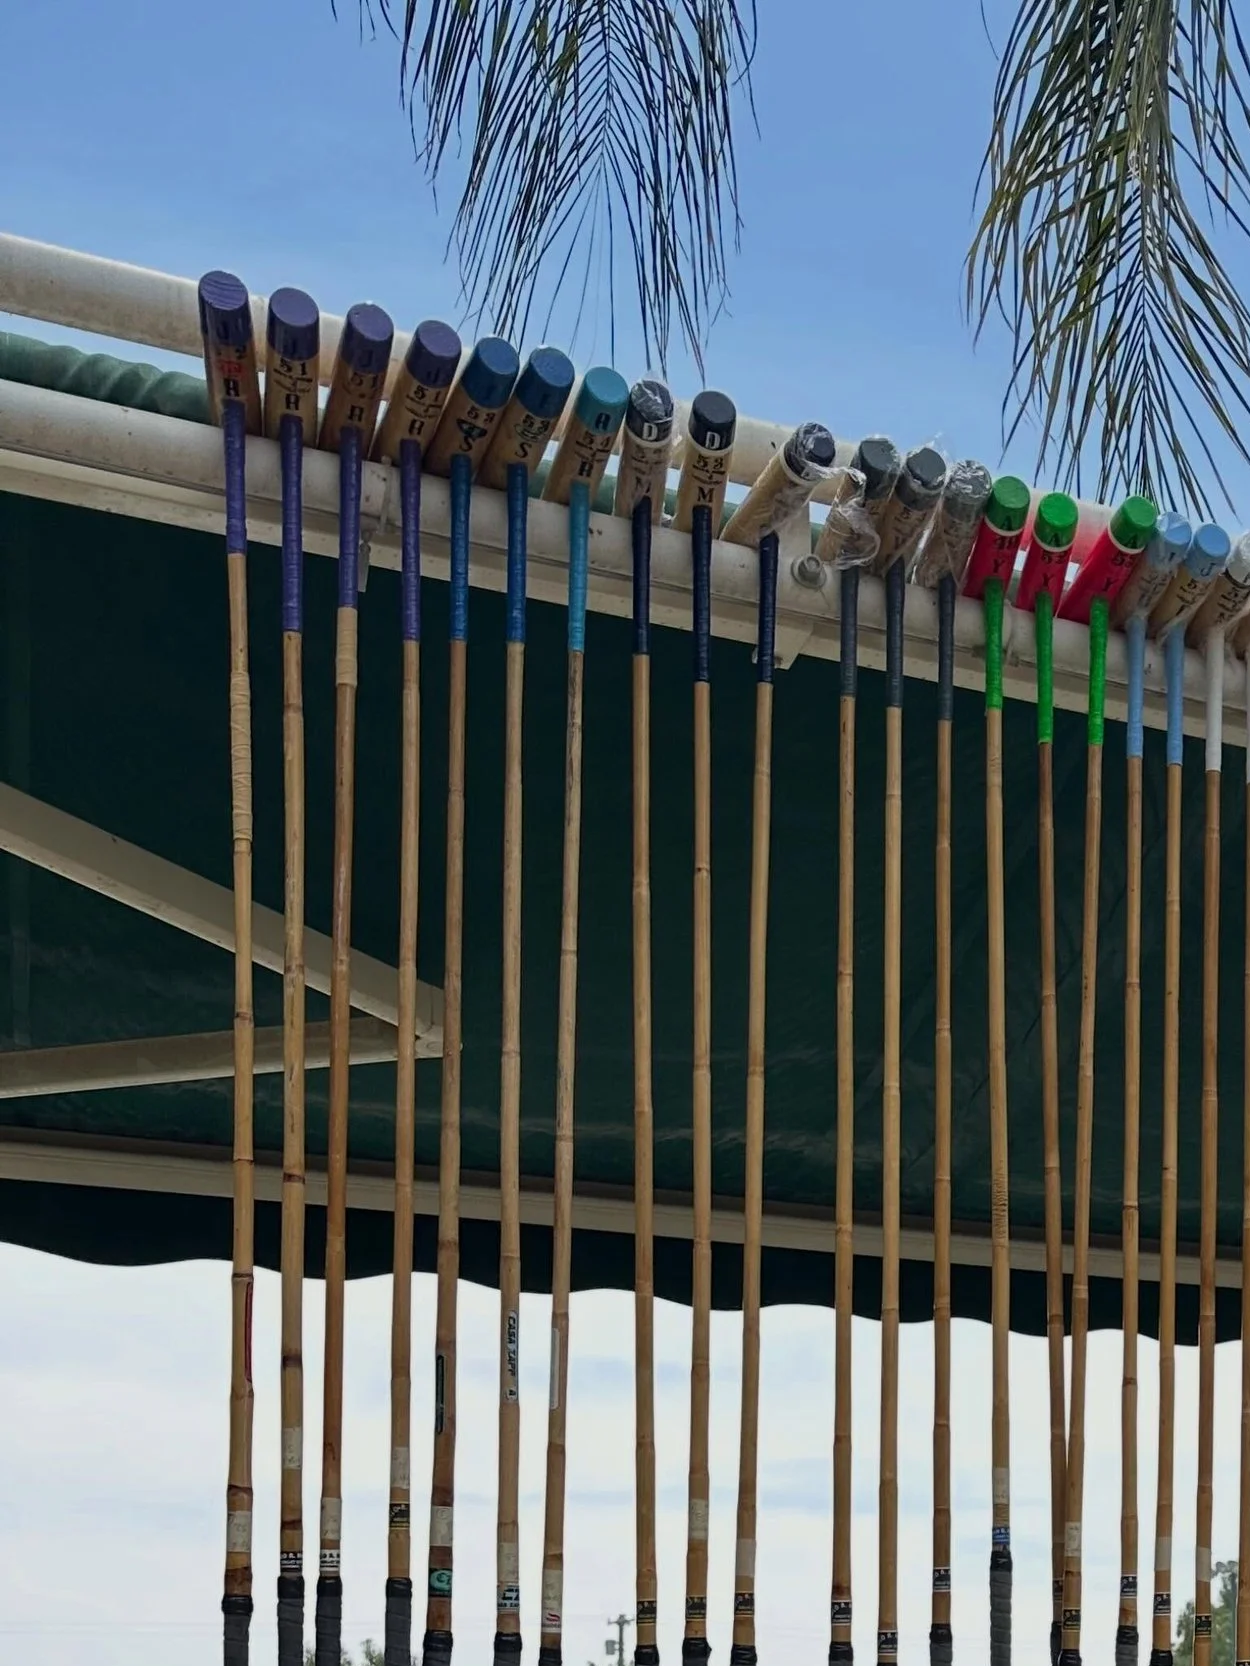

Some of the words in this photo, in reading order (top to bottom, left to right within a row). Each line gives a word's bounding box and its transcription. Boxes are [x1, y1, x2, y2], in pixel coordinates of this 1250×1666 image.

[642, 421, 659, 441] D
[705, 430, 722, 450] D
[514, 442, 533, 459] S
[696, 486, 715, 504] M
[508, 1316, 516, 1344] CASA
